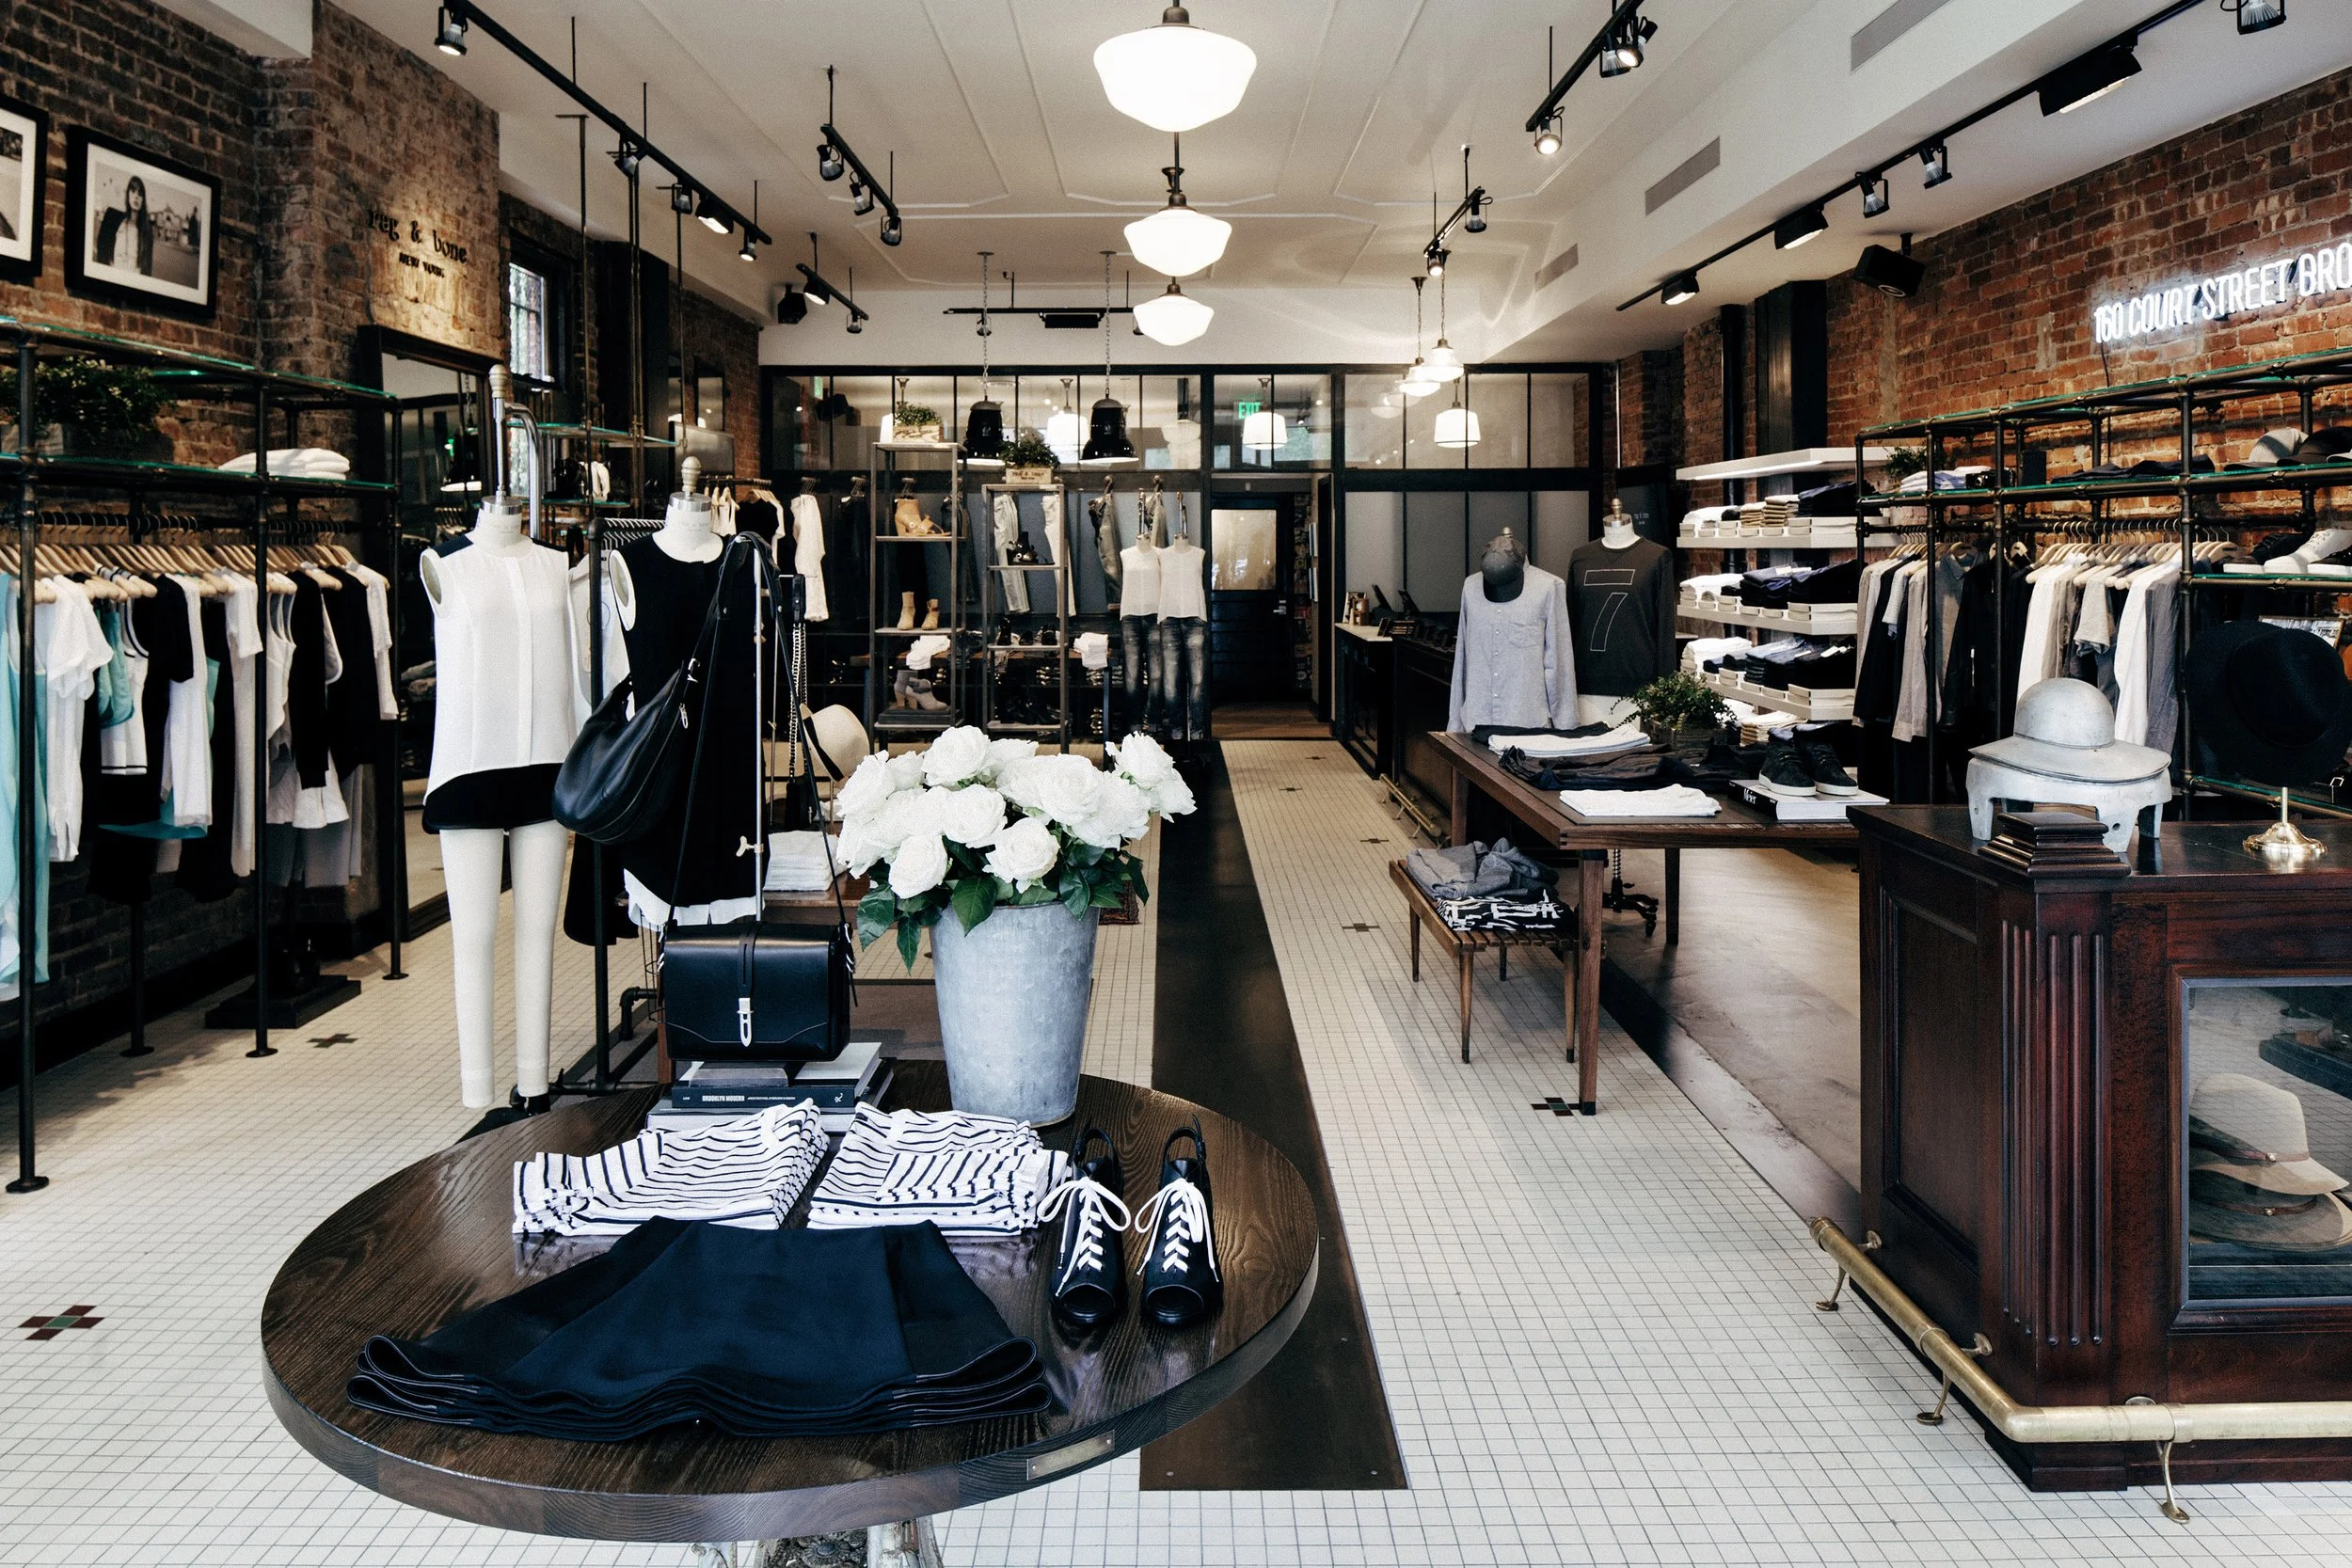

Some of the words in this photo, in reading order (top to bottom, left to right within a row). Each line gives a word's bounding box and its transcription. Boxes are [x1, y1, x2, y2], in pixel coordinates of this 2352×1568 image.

[410, 220, 422, 244] &
[433, 230, 468, 264] bone
[399, 252, 420, 268] NEW
[422, 261, 445, 278] YORK
[2094, 303, 2124, 343] 160
[2129, 283, 2199, 337] COURT
[2201, 258, 2296, 320] STREET
[2298, 242, 2352, 297] BRO
[1238, 402, 1261, 420] EXIT
[1583, 569, 1635, 652] 7
